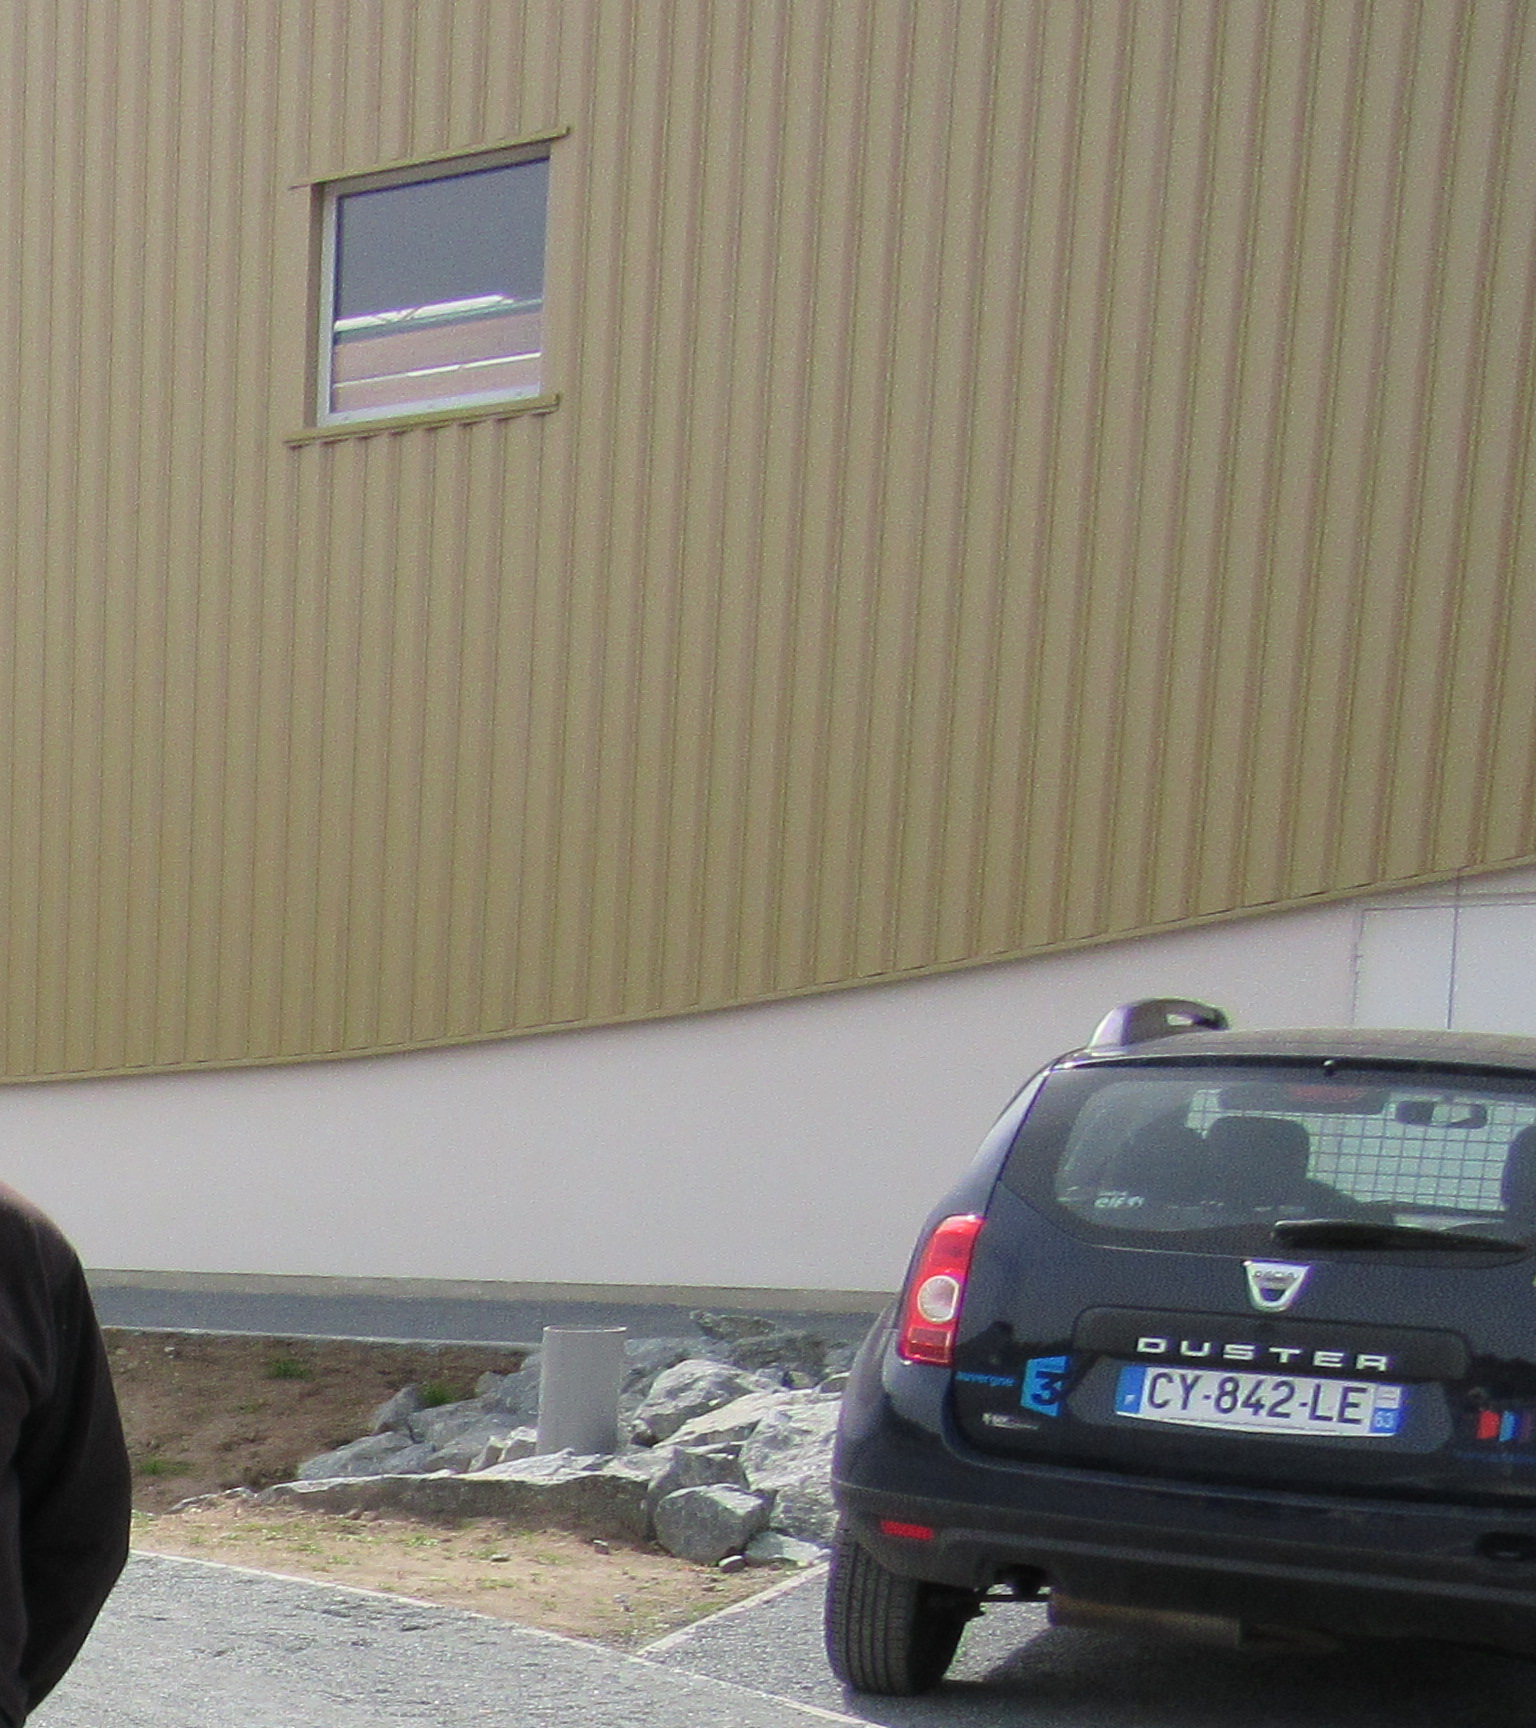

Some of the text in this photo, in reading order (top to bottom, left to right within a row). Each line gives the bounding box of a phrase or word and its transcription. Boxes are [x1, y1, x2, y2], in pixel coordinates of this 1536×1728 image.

[1136, 1336, 1390, 1373] DUSTER
[956, 1370, 1016, 1387] auvergne
[1147, 1371, 1369, 1426] CY-842-LE
[1374, 1411, 1395, 1428] 63
